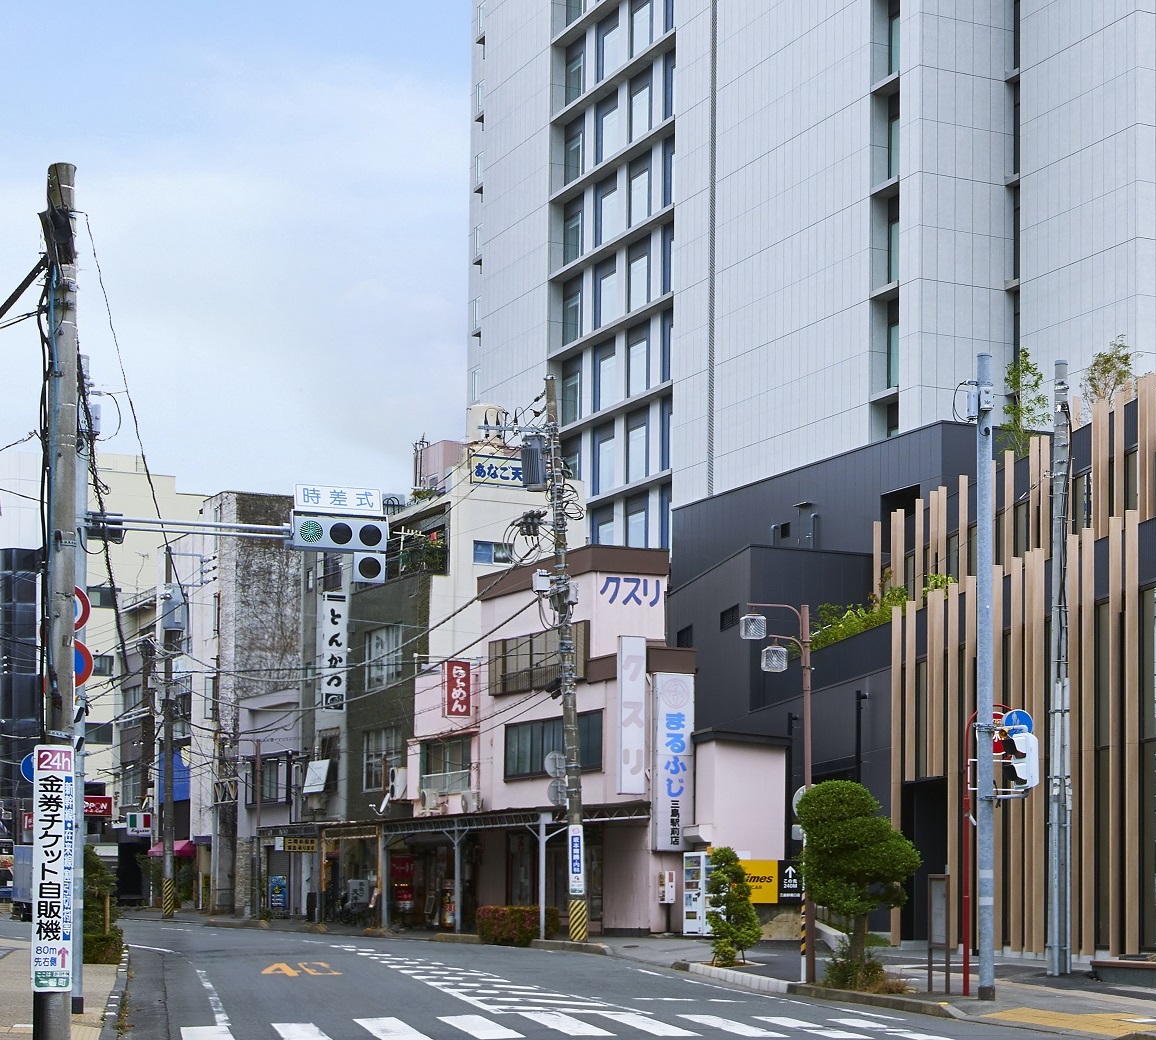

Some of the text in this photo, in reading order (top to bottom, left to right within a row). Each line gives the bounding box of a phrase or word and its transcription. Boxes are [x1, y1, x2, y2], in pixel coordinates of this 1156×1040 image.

[474, 462, 523, 482] あなご天
[303, 487, 374, 508] 時差式
[600, 576, 660, 607] クスリ
[327, 608, 343, 687] とんかつ
[621, 655, 645, 775] クスリ
[39, 751, 71, 770] 24h
[664, 712, 687, 798] まるふじ
[670, 799, 680, 846] 三島駅前店
[36, 774, 63, 941] 金券チケット自販機
[746, 874, 773, 883] imes
[34, 956, 57, 967] 先右側
[35, 945, 57, 955] 80m
